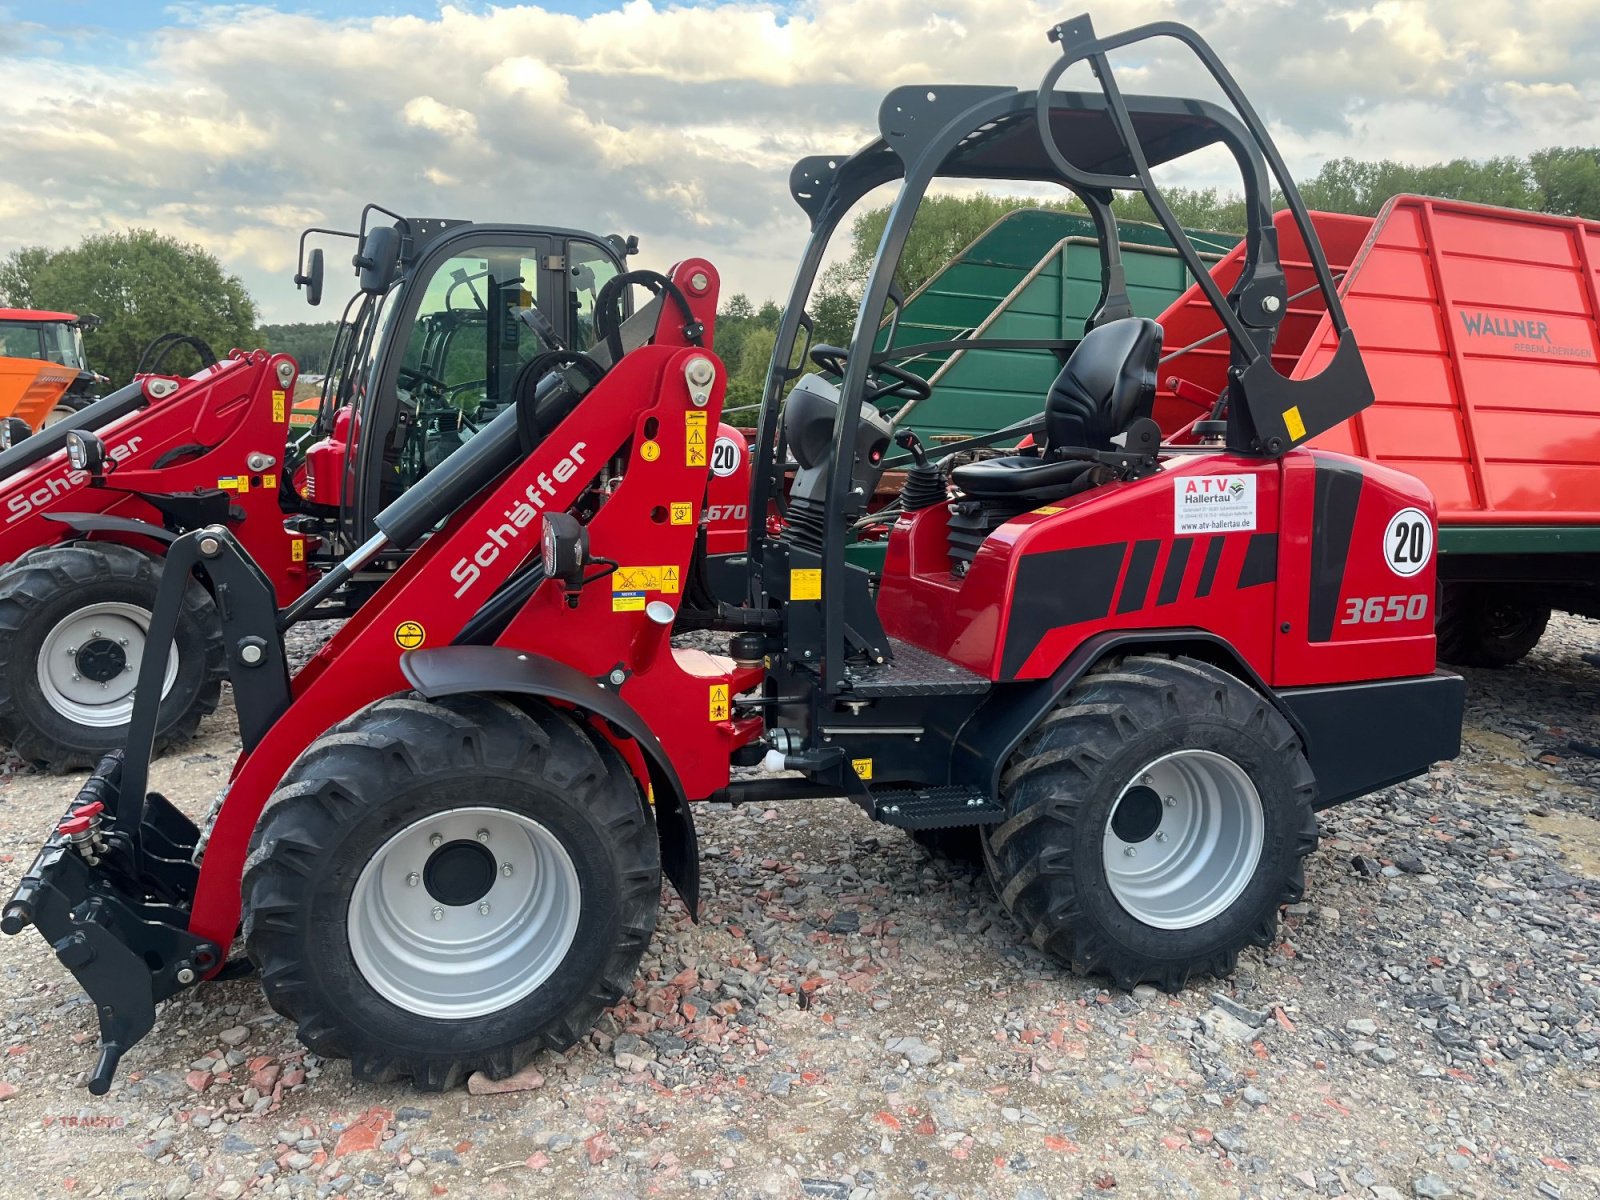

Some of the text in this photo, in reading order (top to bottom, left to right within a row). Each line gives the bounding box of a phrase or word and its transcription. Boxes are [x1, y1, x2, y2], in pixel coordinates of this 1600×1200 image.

[1460, 311, 1551, 344] WALLNER
[1513, 343, 1592, 358] REBENLADEWAGEN
[713, 445, 735, 470] 20
[5, 436, 143, 524] Schäer
[707, 504, 747, 521] 670
[1184, 494, 1231, 504] Hallertau
[450, 441, 587, 600] Schäffer
[1181, 519, 1251, 530] www.atv-hallertau.de
[1393, 521, 1425, 564] 20
[1340, 593, 1429, 625] 3650
